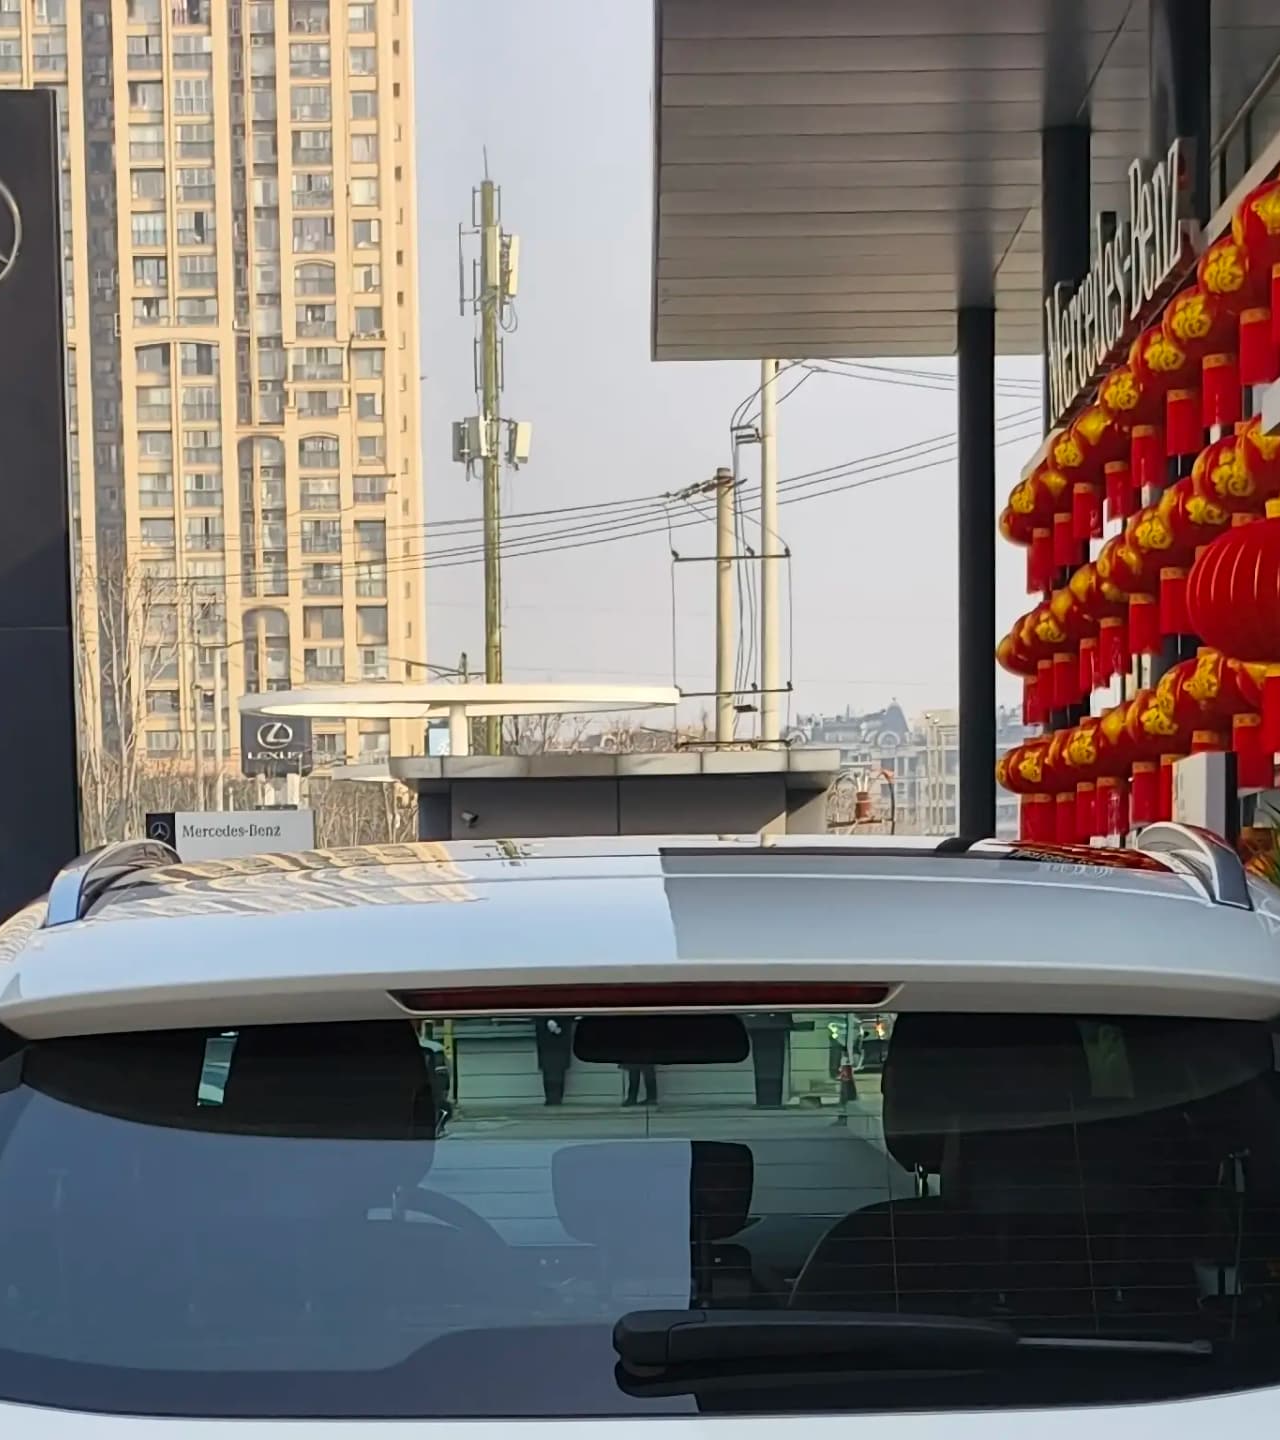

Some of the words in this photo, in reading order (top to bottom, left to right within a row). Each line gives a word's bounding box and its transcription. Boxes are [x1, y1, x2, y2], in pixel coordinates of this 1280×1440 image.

[1045, 137, 1183, 429] Mercedes-Benz
[247, 751, 303, 760] LEXUS
[182, 823, 282, 838] Mercedes-Benz
